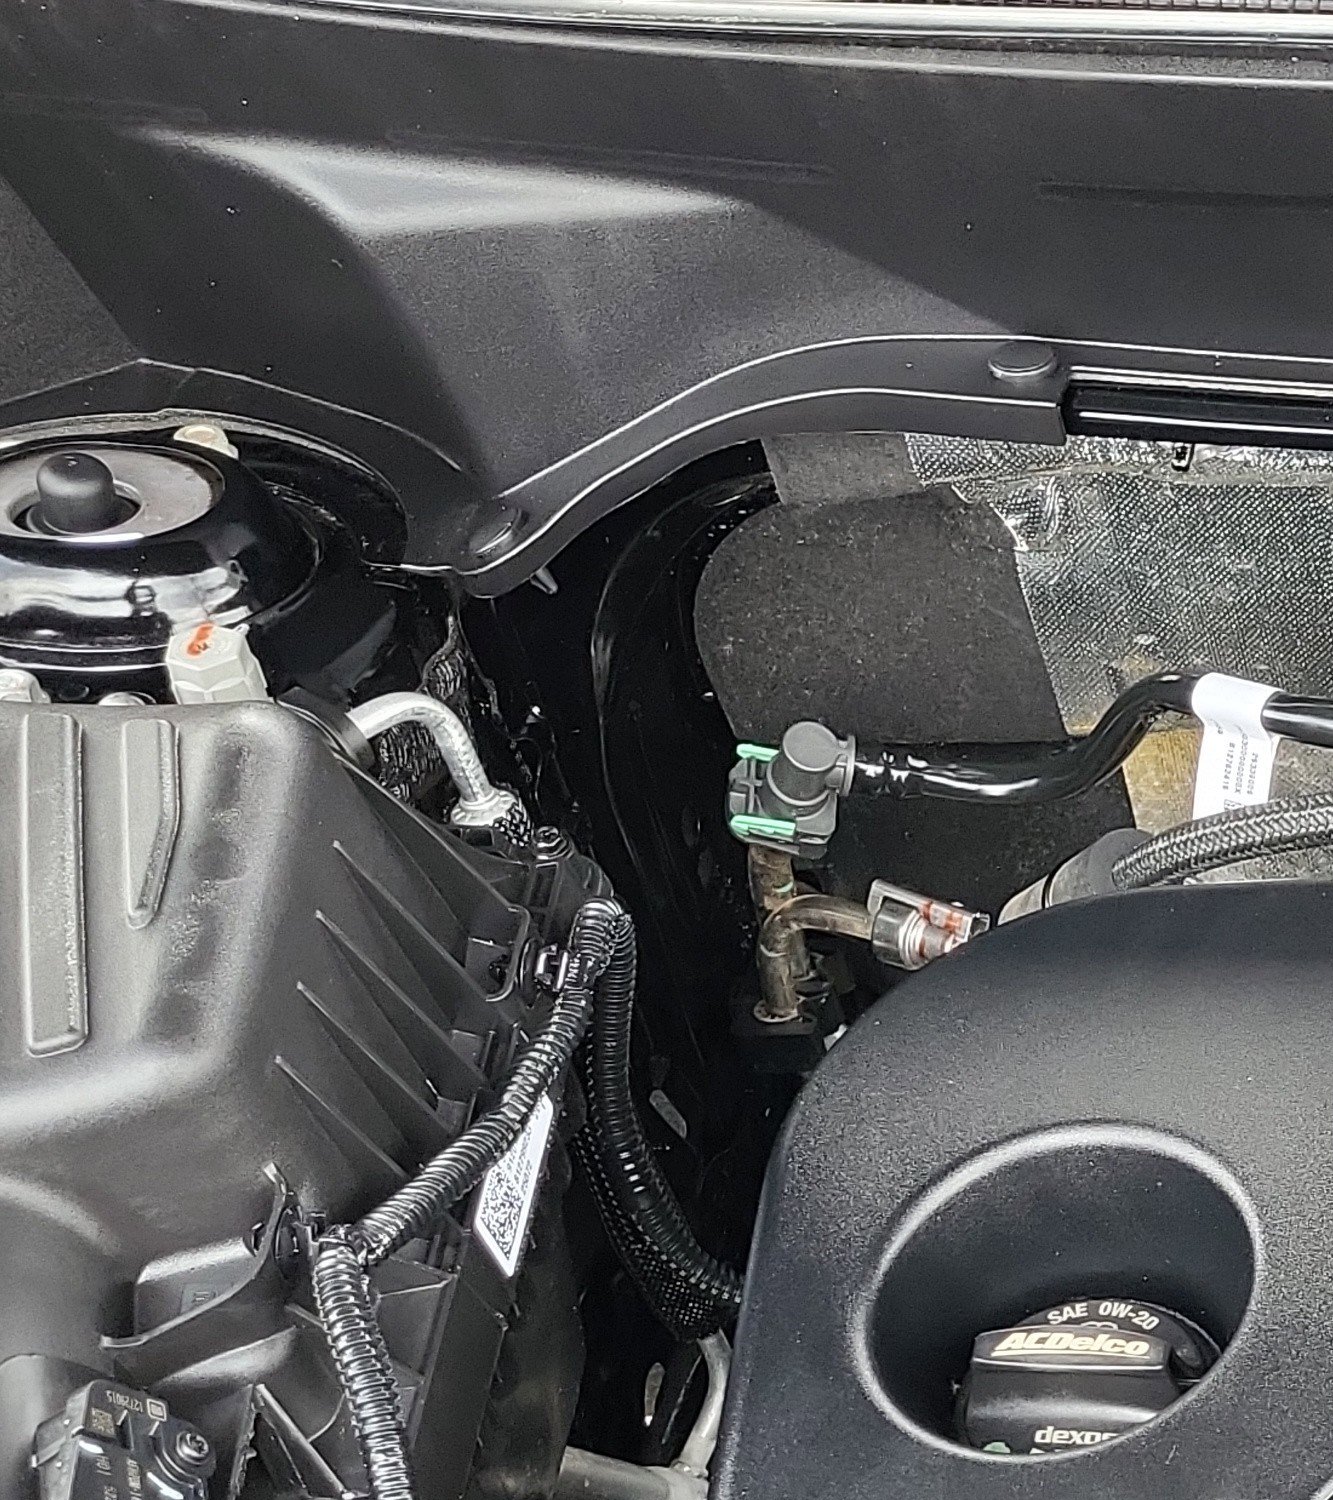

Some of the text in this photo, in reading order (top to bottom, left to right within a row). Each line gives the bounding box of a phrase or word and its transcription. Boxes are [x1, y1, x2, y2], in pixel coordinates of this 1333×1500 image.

[1047, 1301, 1160, 1331] SAE 0W-20
[994, 1332, 1152, 1356] ACDelco
